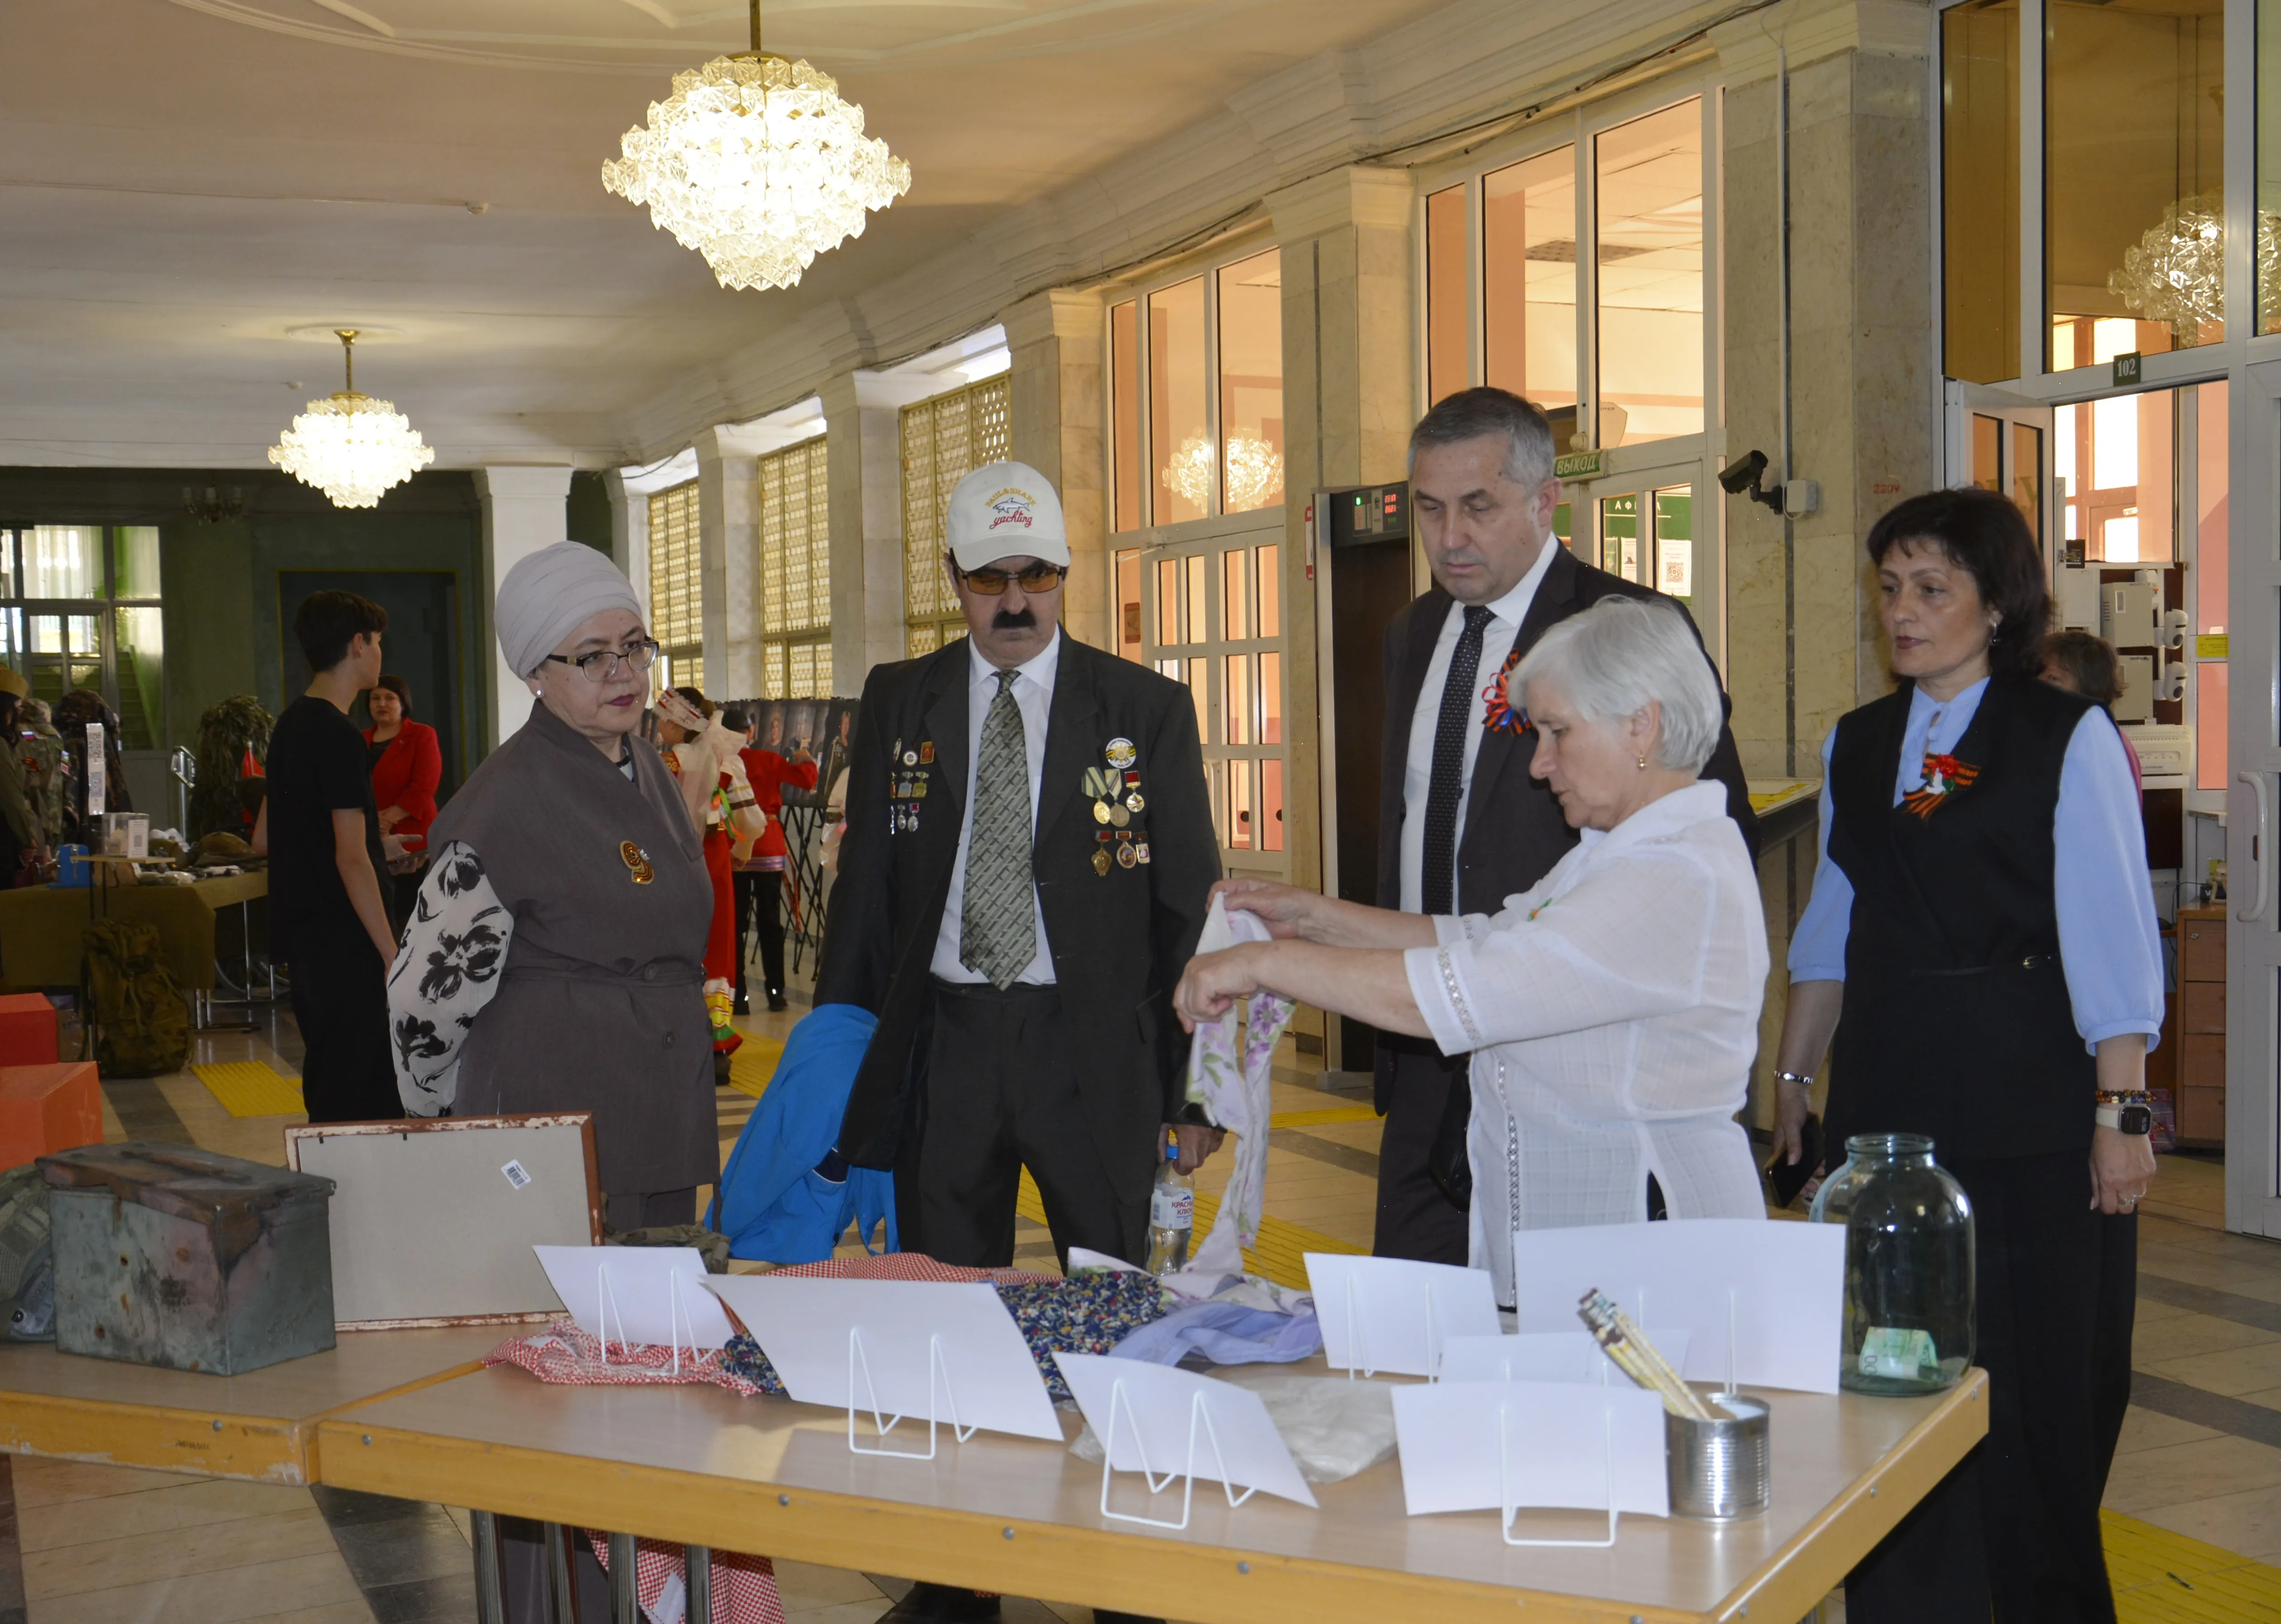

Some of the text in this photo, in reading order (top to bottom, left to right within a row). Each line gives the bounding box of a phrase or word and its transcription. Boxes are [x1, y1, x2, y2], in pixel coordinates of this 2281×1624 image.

[2117, 358, 2136, 377] 102
[1556, 455, 1596, 475] ВЫХОД
[1873, 483, 1901, 494] 220V
[1614, 500, 1661, 510] АФА
[989, 510, 1033, 529] yachting
